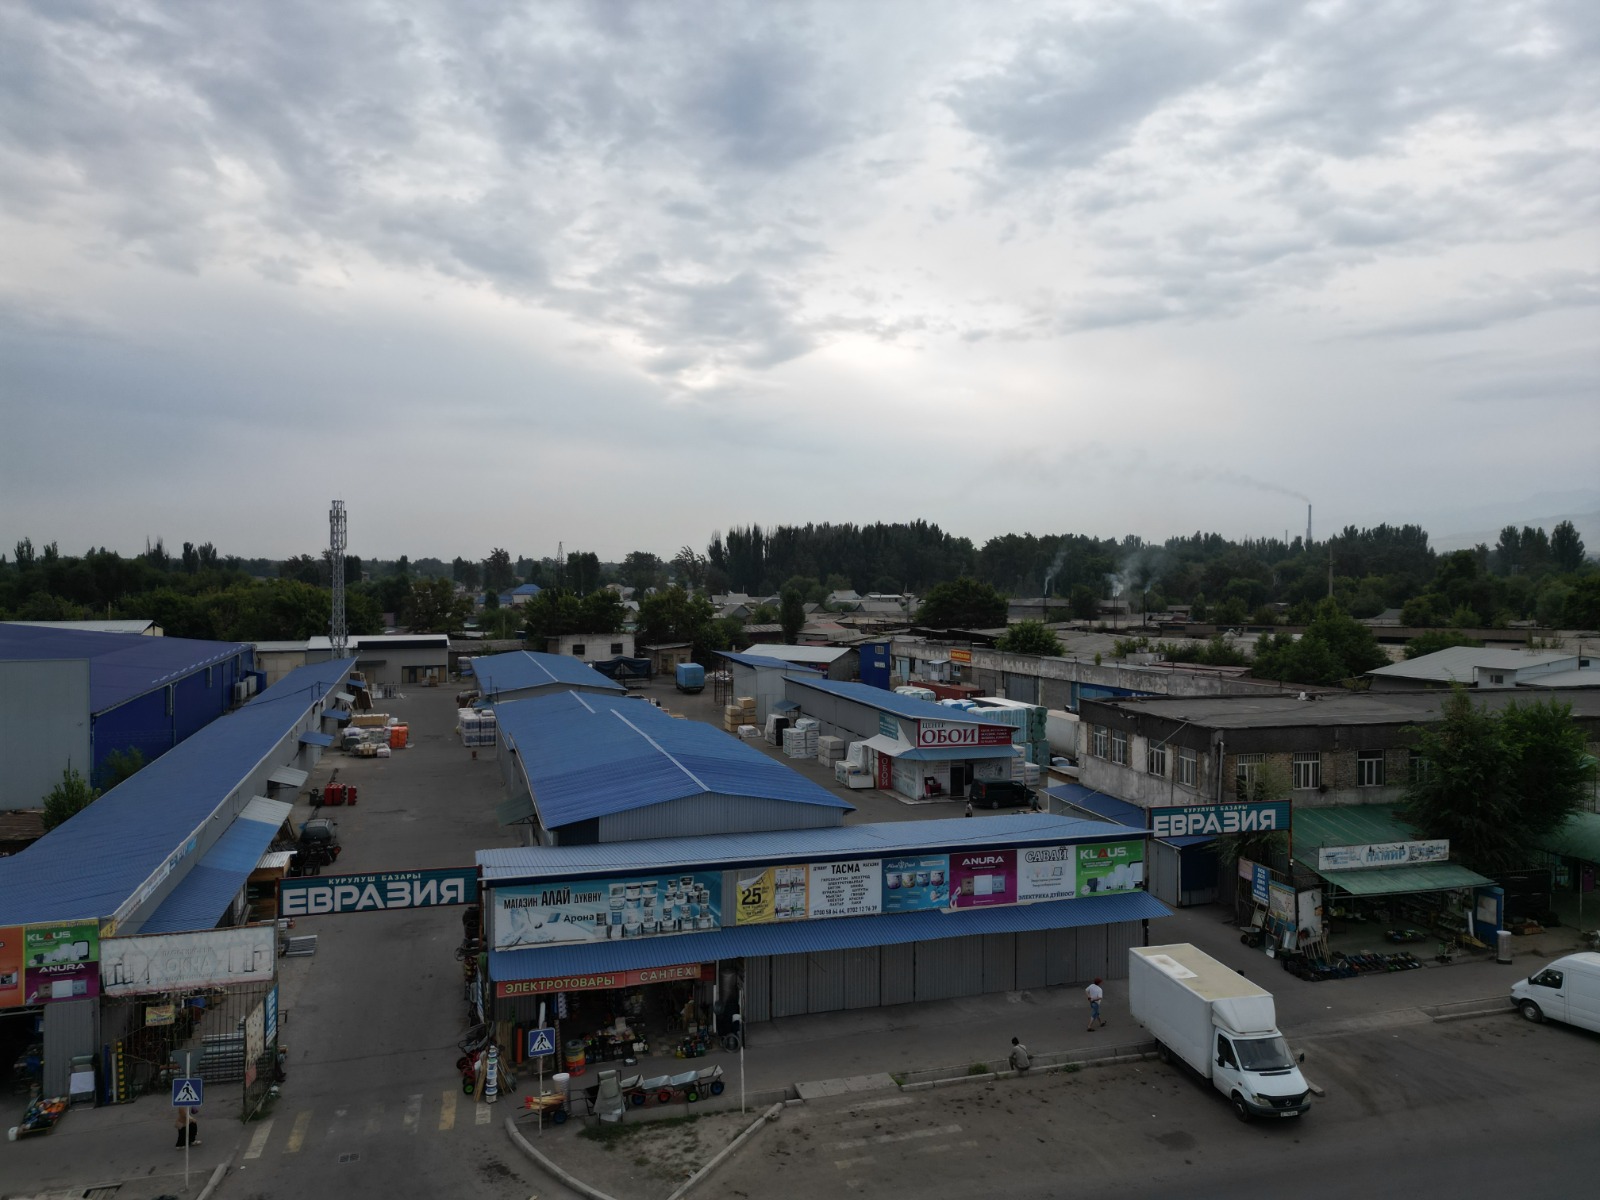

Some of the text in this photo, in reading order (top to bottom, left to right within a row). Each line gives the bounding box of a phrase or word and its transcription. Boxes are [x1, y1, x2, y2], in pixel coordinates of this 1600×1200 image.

[921, 728, 977, 744] ОБОИ
[881, 757, 889, 786] ОБОИ
[1154, 809, 1276, 837] ЕВРАЗИЯ
[1025, 848, 1068, 864] САВАЙ
[1080, 847, 1127, 860] KLAUS
[1366, 849, 1406, 862] ПАМИР
[961, 856, 1005, 866] ANURA
[831, 863, 860, 875] ТАСМА
[329, 873, 421, 885] КУРУЛУШ БАЗАРЫ
[283, 878, 465, 916] ЕВРАЗИЯ
[503, 897, 539, 910] МАГАЗИН
[541, 886, 571, 908] АЛАЙ
[741, 887, 762, 905] 25
[563, 913, 595, 923] Арона
[26, 930, 71, 942] KLAUS
[38, 963, 86, 974] ANURA
[505, 976, 615, 994] ЭЛЕКТРОТОВАРЫ
